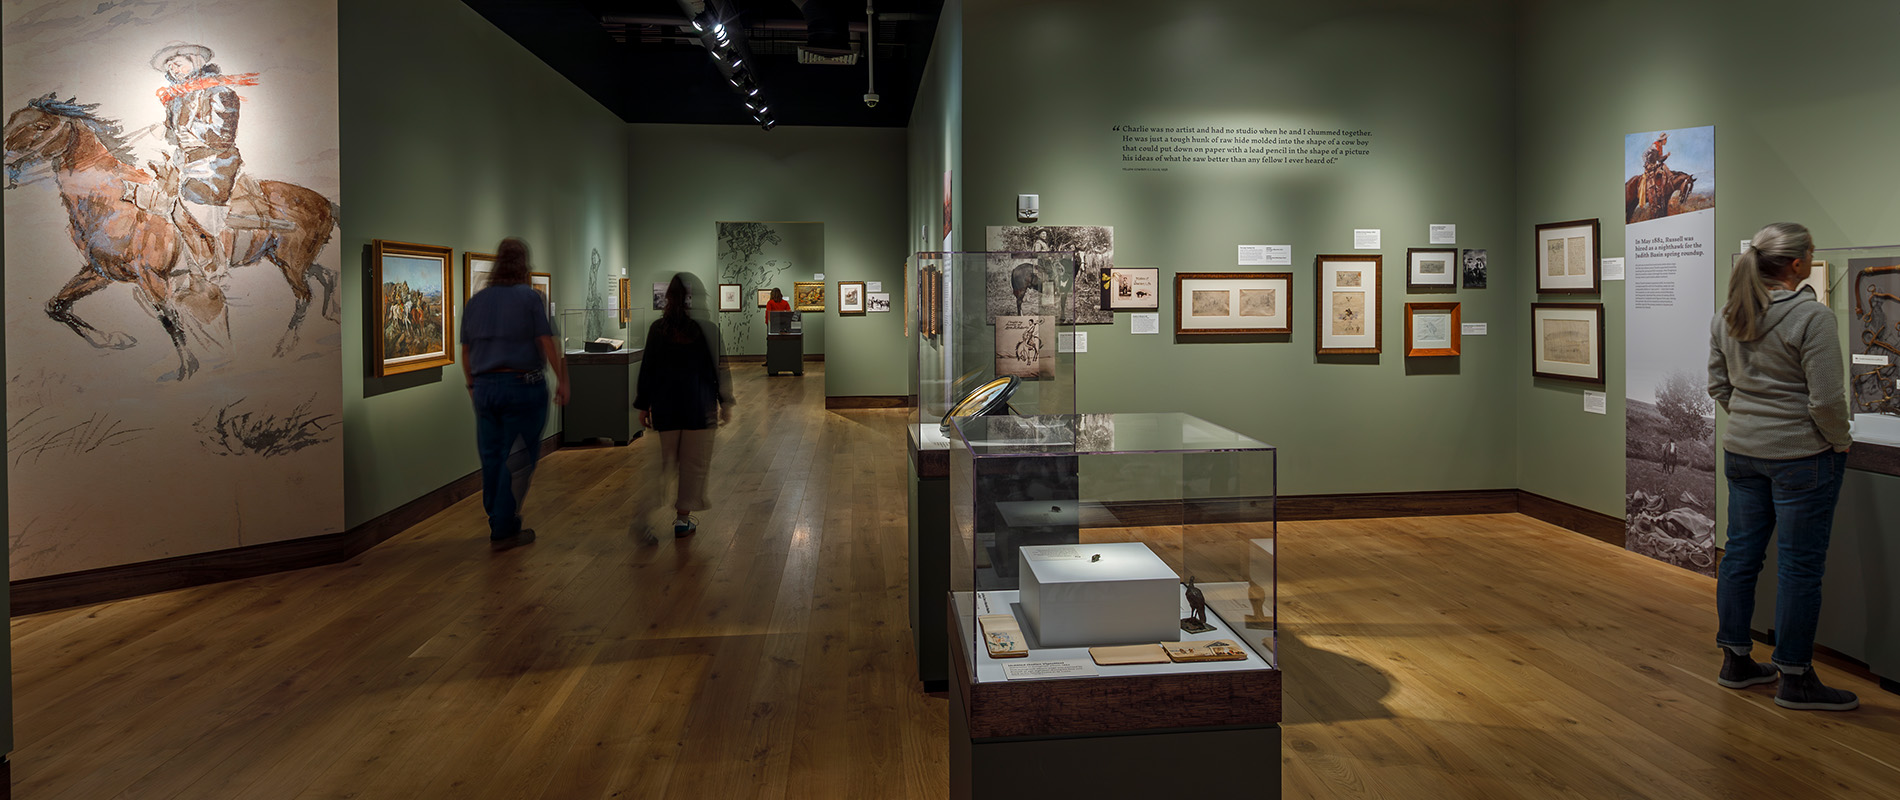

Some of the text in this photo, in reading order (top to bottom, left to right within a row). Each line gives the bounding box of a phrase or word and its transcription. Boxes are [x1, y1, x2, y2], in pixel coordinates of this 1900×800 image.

[1170, 136, 1190, 144] tough
[1306, 138, 1326, 146] shape
[1345, 148, 1369, 156] picture
[1659, 243, 1683, 251] nighthawk
